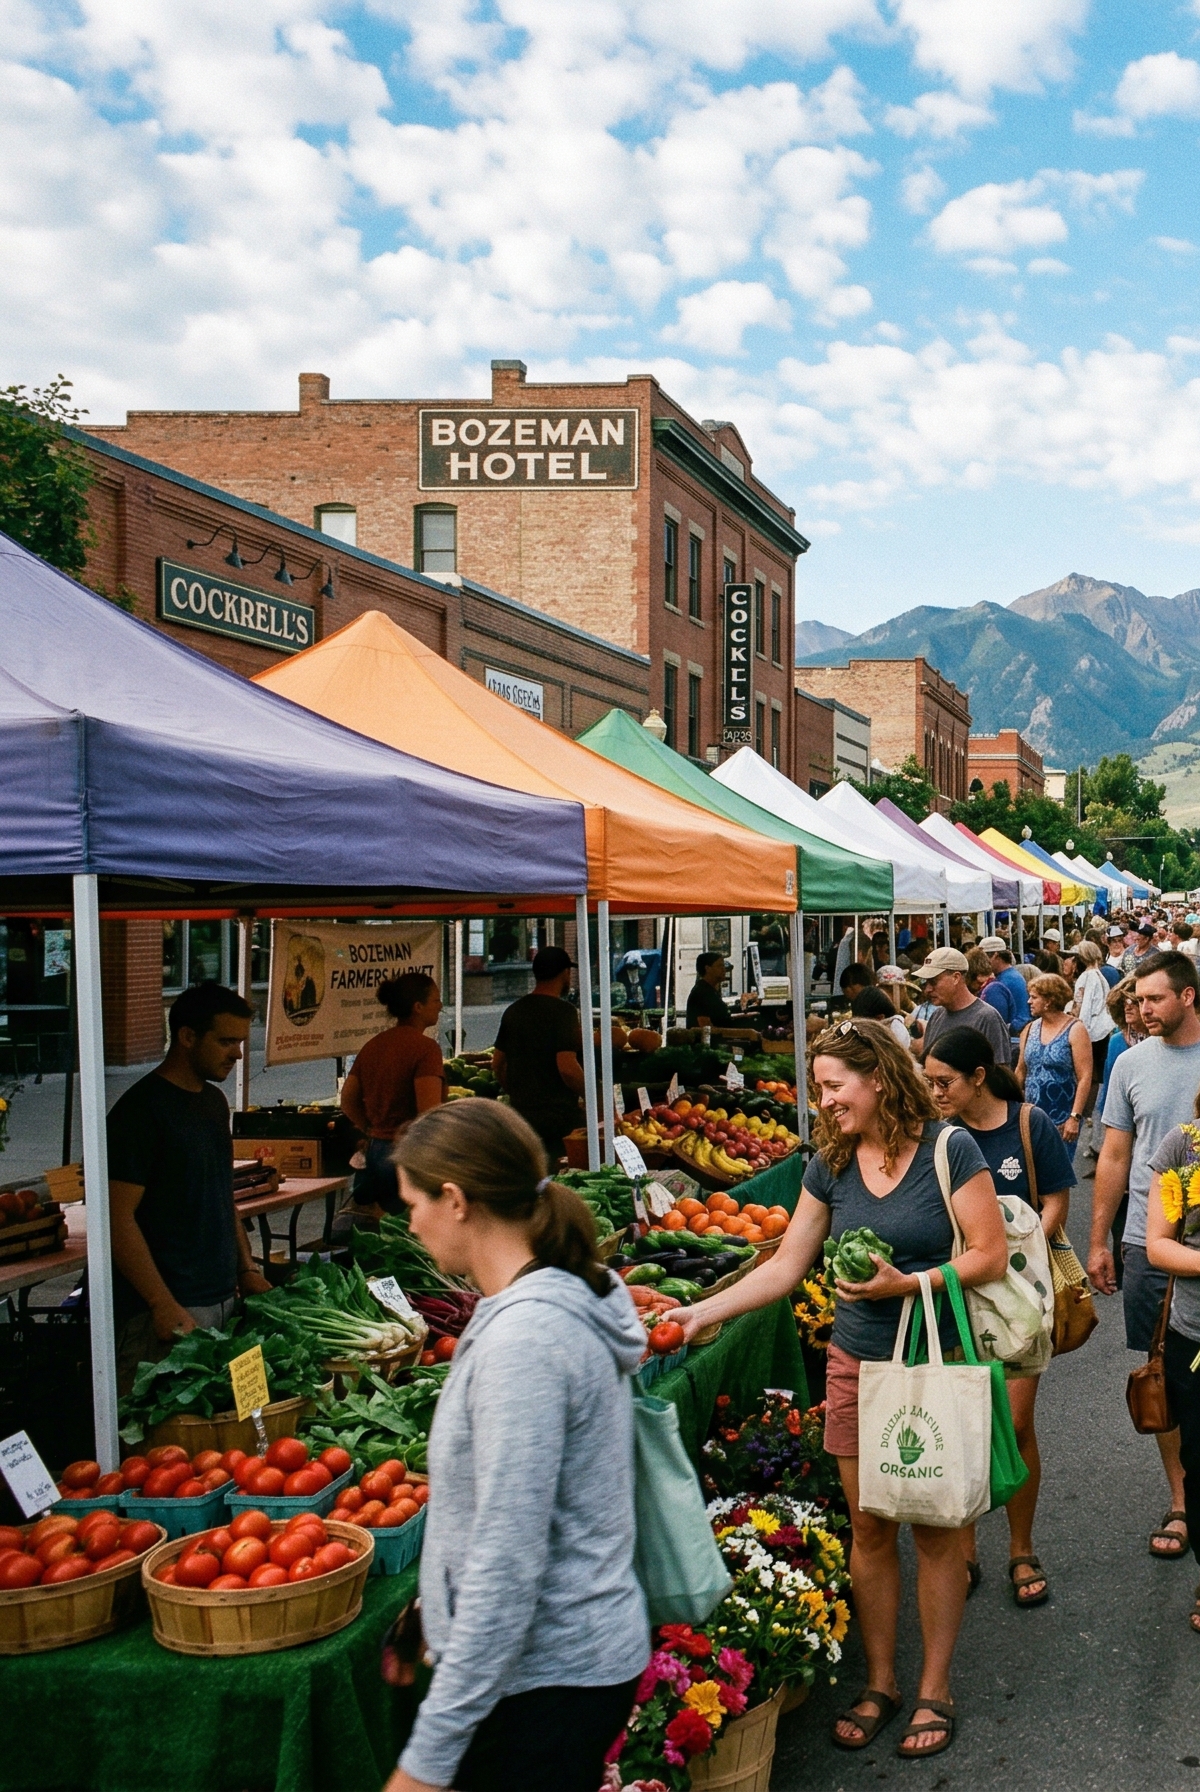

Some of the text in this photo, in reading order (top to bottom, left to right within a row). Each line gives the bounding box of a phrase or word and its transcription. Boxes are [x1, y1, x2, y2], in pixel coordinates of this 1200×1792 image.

[431, 418, 625, 446] BOZEMAN
[449, 452, 607, 481] HOTEL
[170, 577, 309, 645] COCKRELL'S
[348, 942, 412, 963] BOZEMAN
[330, 968, 389, 989] FARMERS
